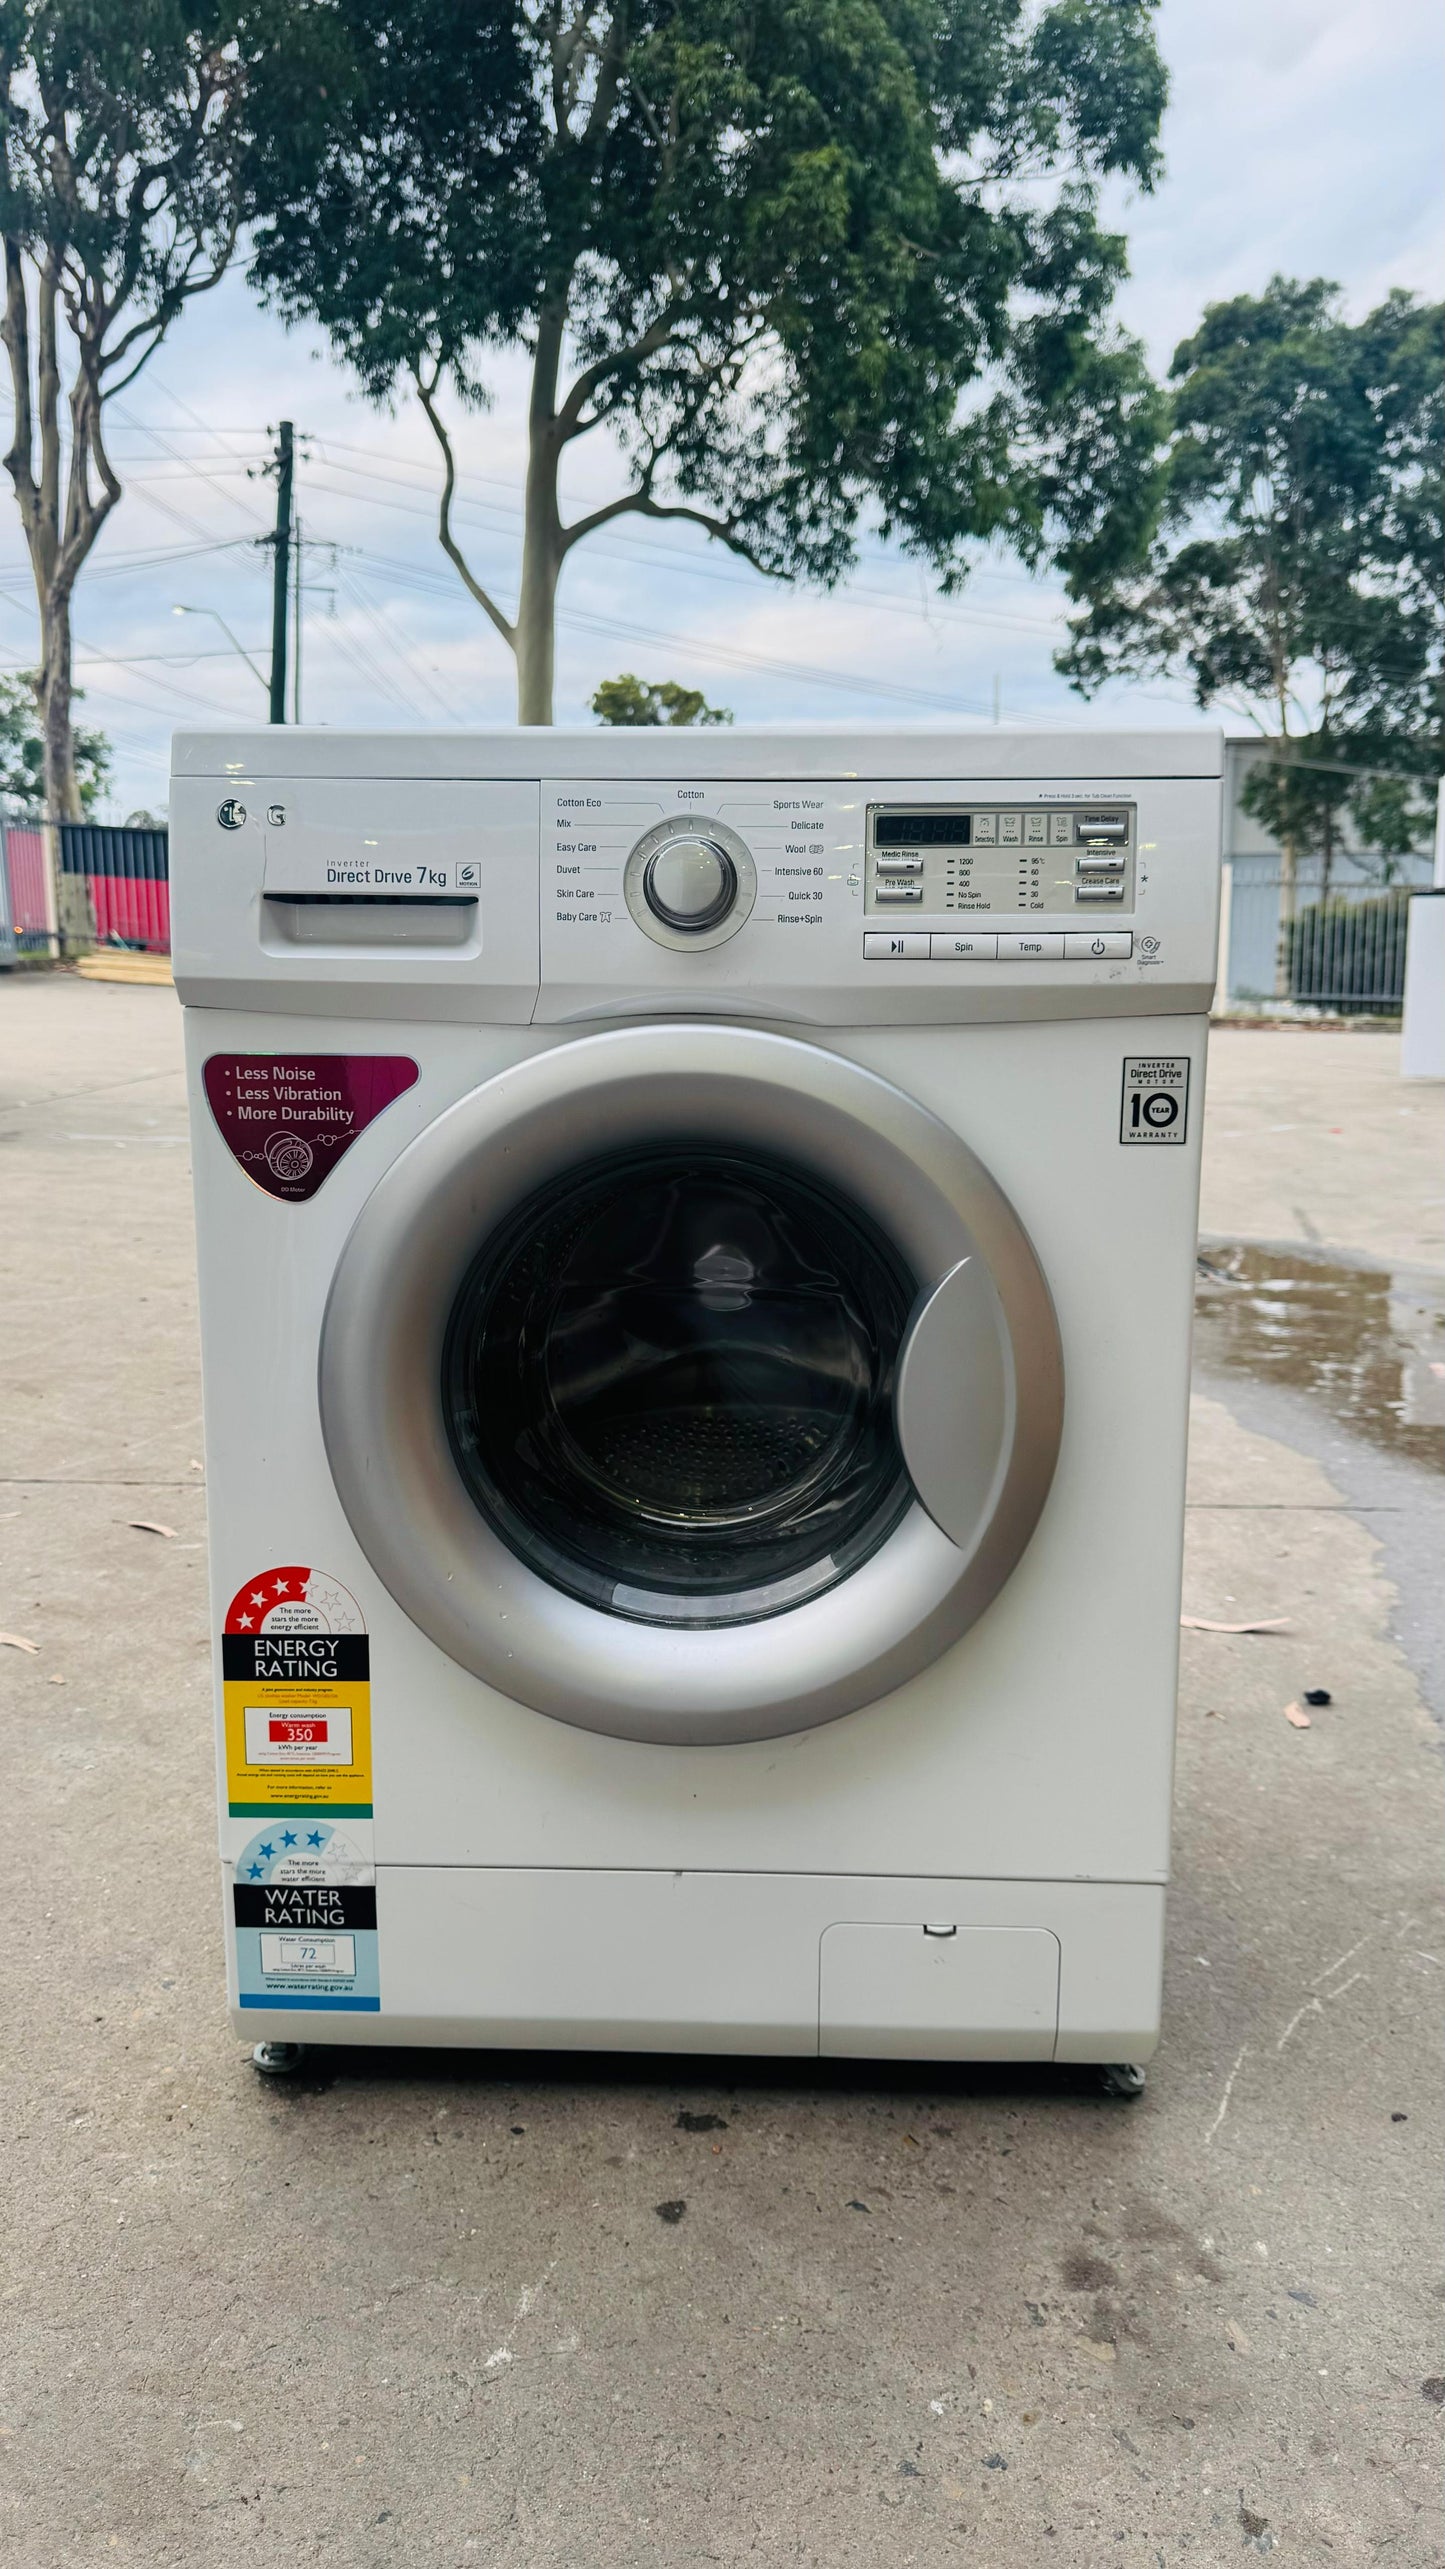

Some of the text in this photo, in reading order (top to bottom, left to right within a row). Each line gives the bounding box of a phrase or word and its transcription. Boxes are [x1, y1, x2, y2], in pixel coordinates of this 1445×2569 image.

[677, 790, 704, 799] Cotton
[557, 798, 602, 807] Cotton Eco
[773, 800, 824, 810] Sports Wear
[556, 819, 571, 828] Mix
[791, 821, 824, 830] Delicate
[556, 843, 597, 852] Easy Care
[785, 844, 806, 853] Wool
[326, 860, 370, 868] Inverter
[556, 865, 580, 874] Duvet
[775, 867, 823, 876] Intensive 60
[327, 869, 370, 883] Direct
[375, 869, 412, 883] Drive
[556, 889, 594, 898] Skin Care
[788, 892, 823, 900] Quick 30
[556, 912, 598, 922] Baby Care
[778, 914, 823, 924] Rinse+Spin
[955, 942, 973, 952] Spin
[1019, 942, 1042, 952] Temp
[236, 1066, 316, 1080] Less Noise
[1131, 1069, 1182, 1078] Direct Drive
[236, 1086, 342, 1101] Less Vibration
[238, 1107, 354, 1124] More Durability
[1131, 1093, 1178, 1128] 10
[254, 1640, 339, 1656] ENERGY
[255, 1660, 337, 1677] RATING
[287, 1728, 312, 1741] 350
[265, 1889, 342, 1906] WATER
[265, 1908, 344, 1925] RATING
[300, 1947, 316, 1959] 72
[266, 1983, 353, 1992] www.waterrating.gov.au
